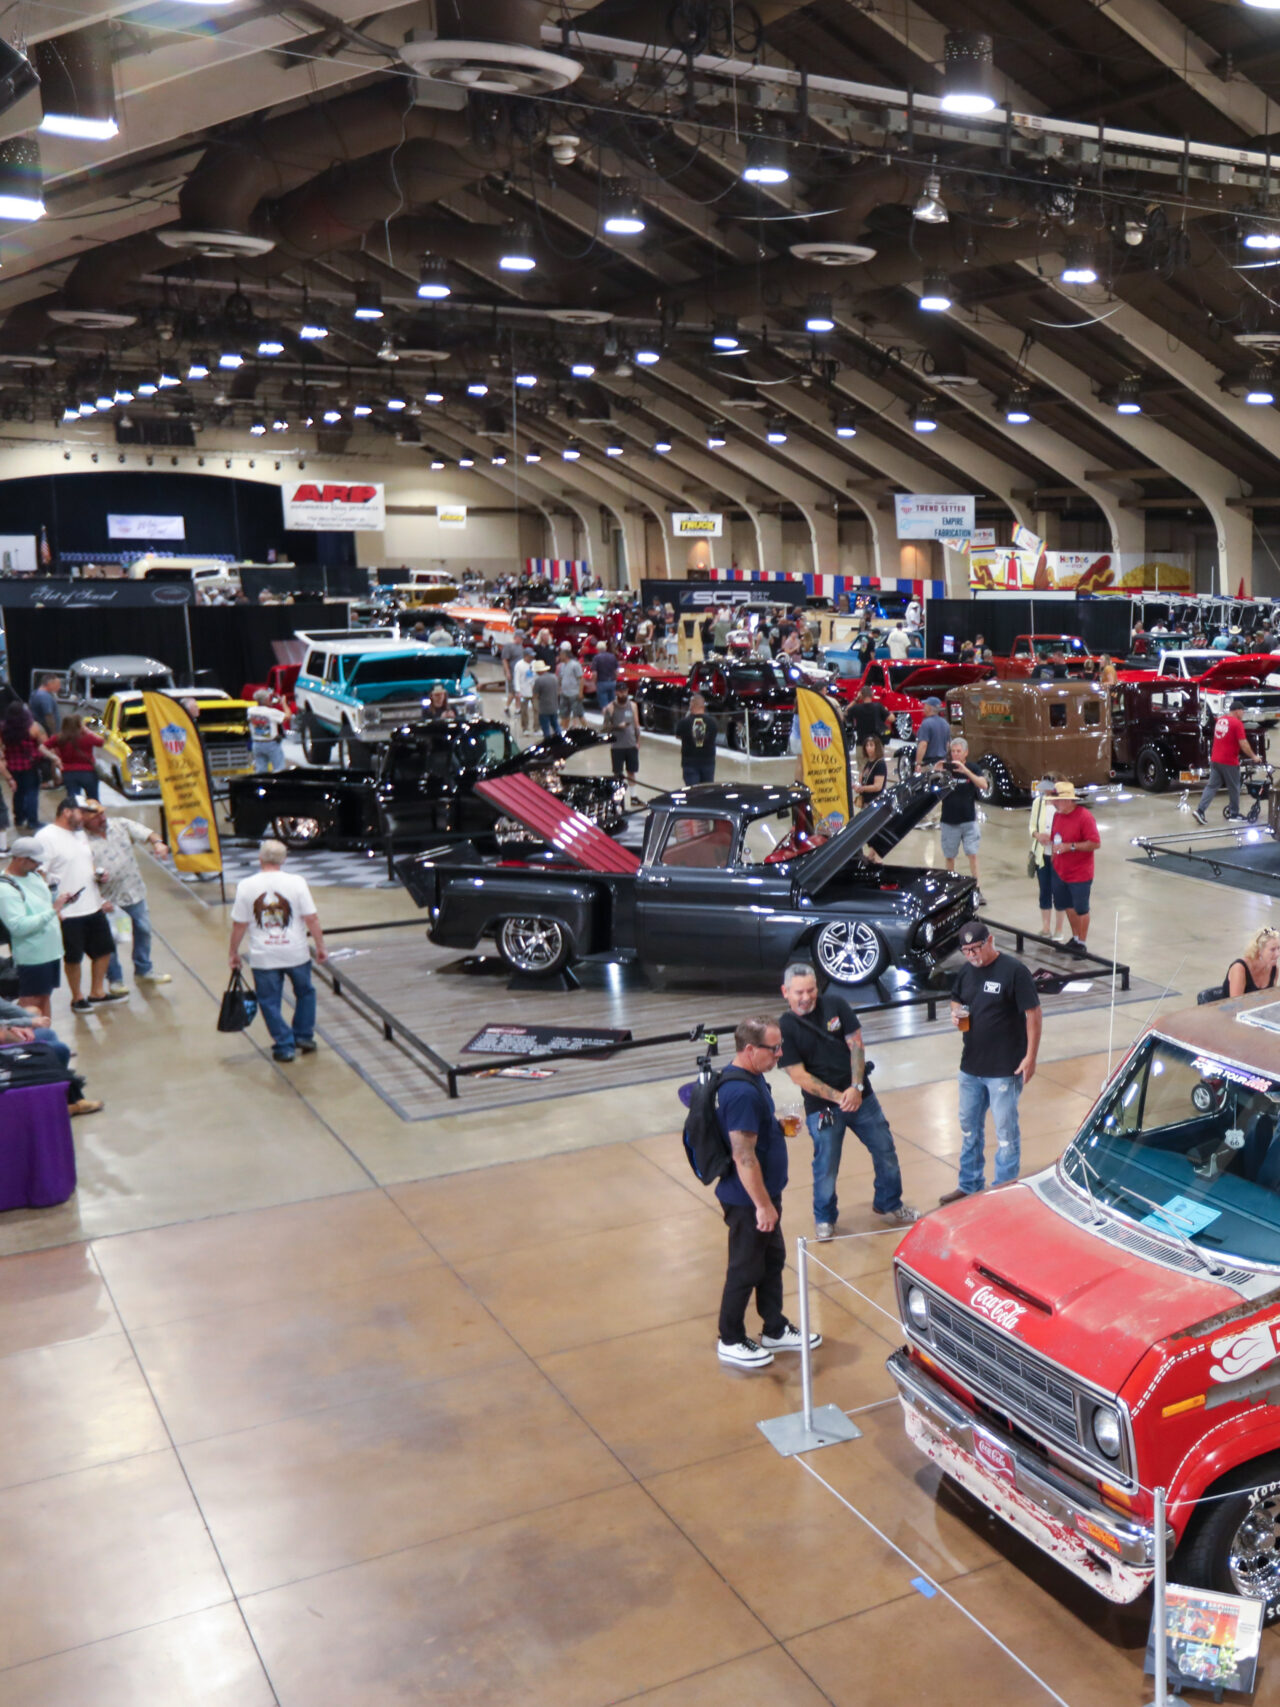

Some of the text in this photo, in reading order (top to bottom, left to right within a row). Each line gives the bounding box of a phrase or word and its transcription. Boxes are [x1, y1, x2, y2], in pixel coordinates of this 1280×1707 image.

[291, 484, 378, 503] ARP
[916, 504, 966, 512] TREND SETTER
[680, 520, 715, 532] TRUCK
[942, 517, 964, 526] EMPIRE
[934, 528, 971, 538] FABRICATION
[1059, 555, 1089, 564] HOT DOG
[811, 753, 837, 764] 2026
[1190, 1059, 1224, 1077] POR
[970, 1285, 1028, 1330] Coca-Cola
